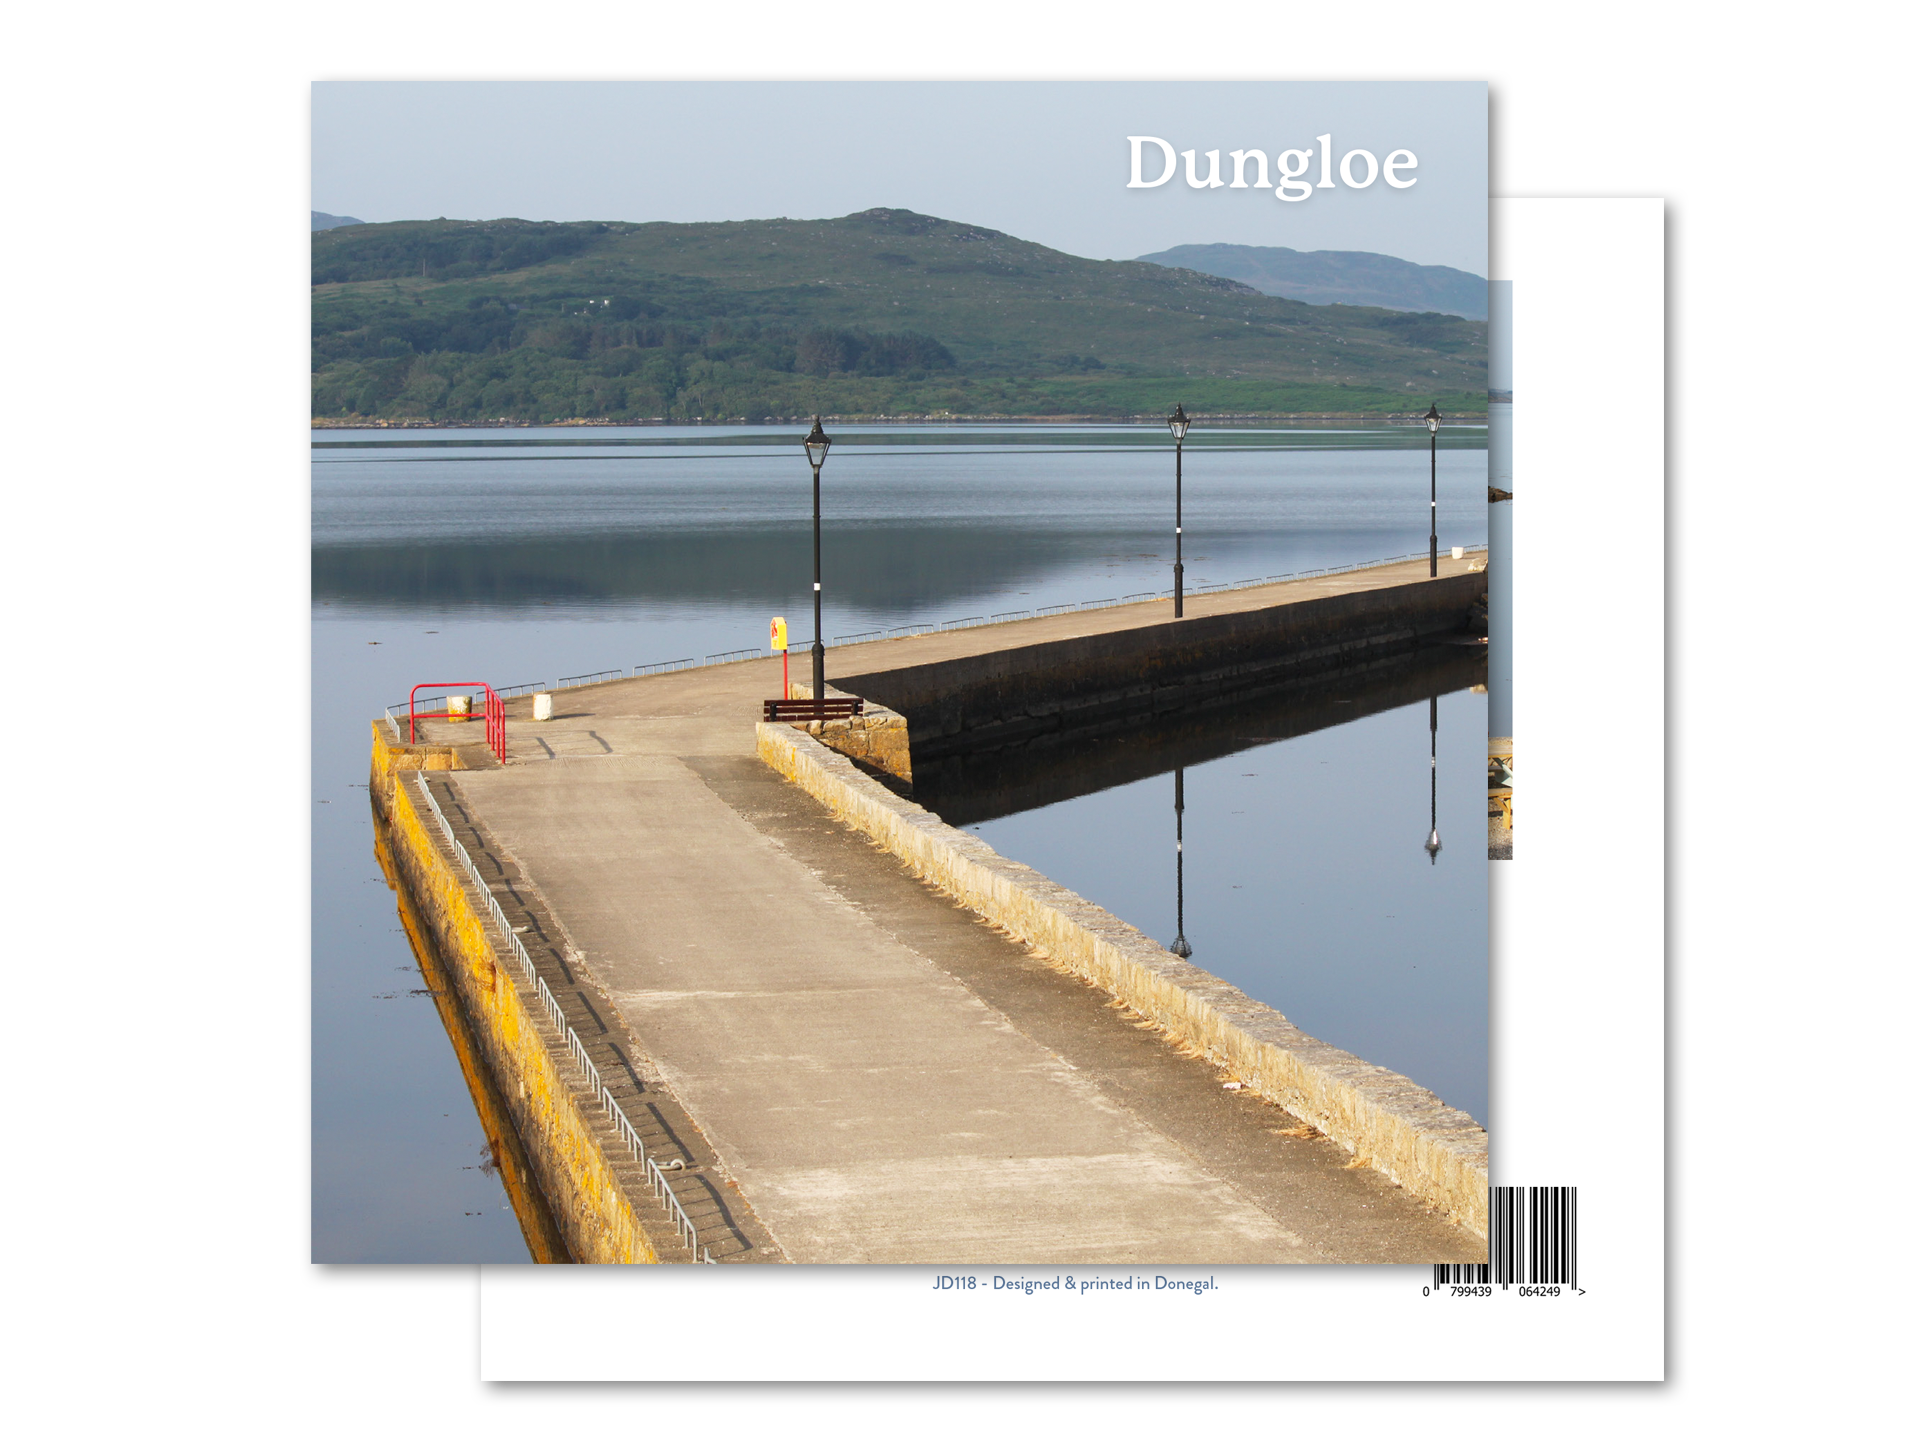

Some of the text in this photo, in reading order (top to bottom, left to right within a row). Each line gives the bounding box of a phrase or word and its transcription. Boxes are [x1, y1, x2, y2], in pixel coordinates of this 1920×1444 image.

[1127, 134, 1417, 201] Dungloe
[933, 1276, 977, 1290] JD118
[994, 1276, 1060, 1296] Designed
[1065, 1276, 1077, 1290] &
[1082, 1276, 1133, 1296] printed
[1138, 1277, 1150, 1290] in
[1156, 1276, 1219, 1296] Donegal.
[1422, 1286, 1430, 1297] 0
[1450, 1286, 1492, 1297] 799439
[1518, 1286, 1561, 1297] 064249
